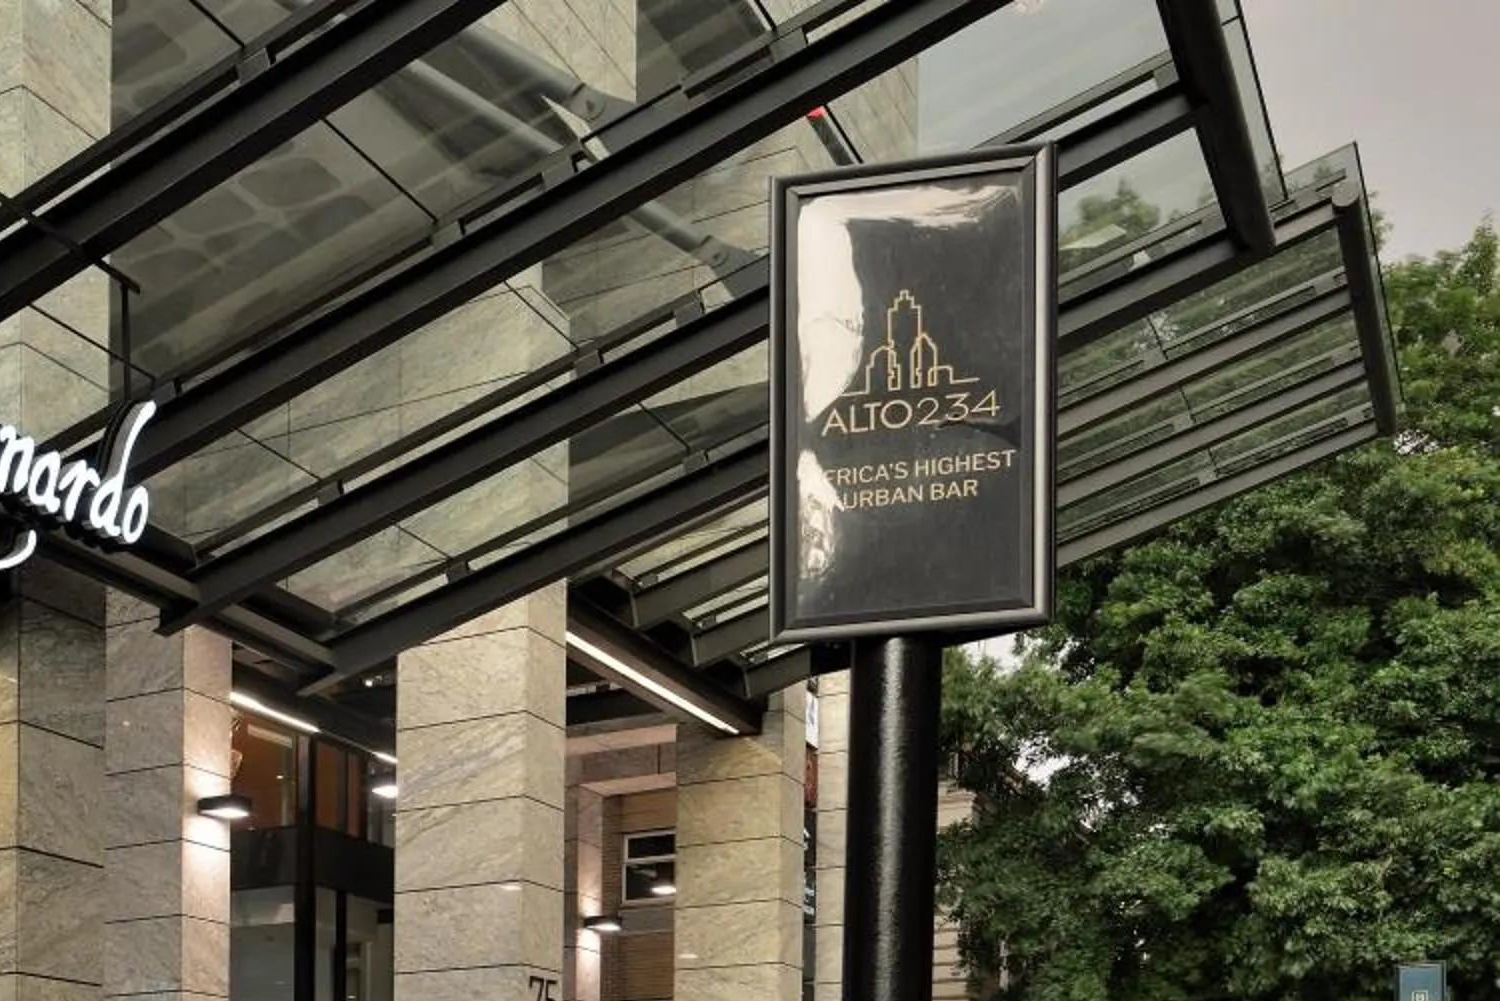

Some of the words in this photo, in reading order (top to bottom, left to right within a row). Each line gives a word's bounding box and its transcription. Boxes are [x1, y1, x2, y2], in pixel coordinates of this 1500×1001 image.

[822, 461, 909, 487] FRICA'S
[914, 449, 1017, 478] HIGHEST
[843, 484, 924, 510] URBAN
[929, 479, 978, 502] BAR
